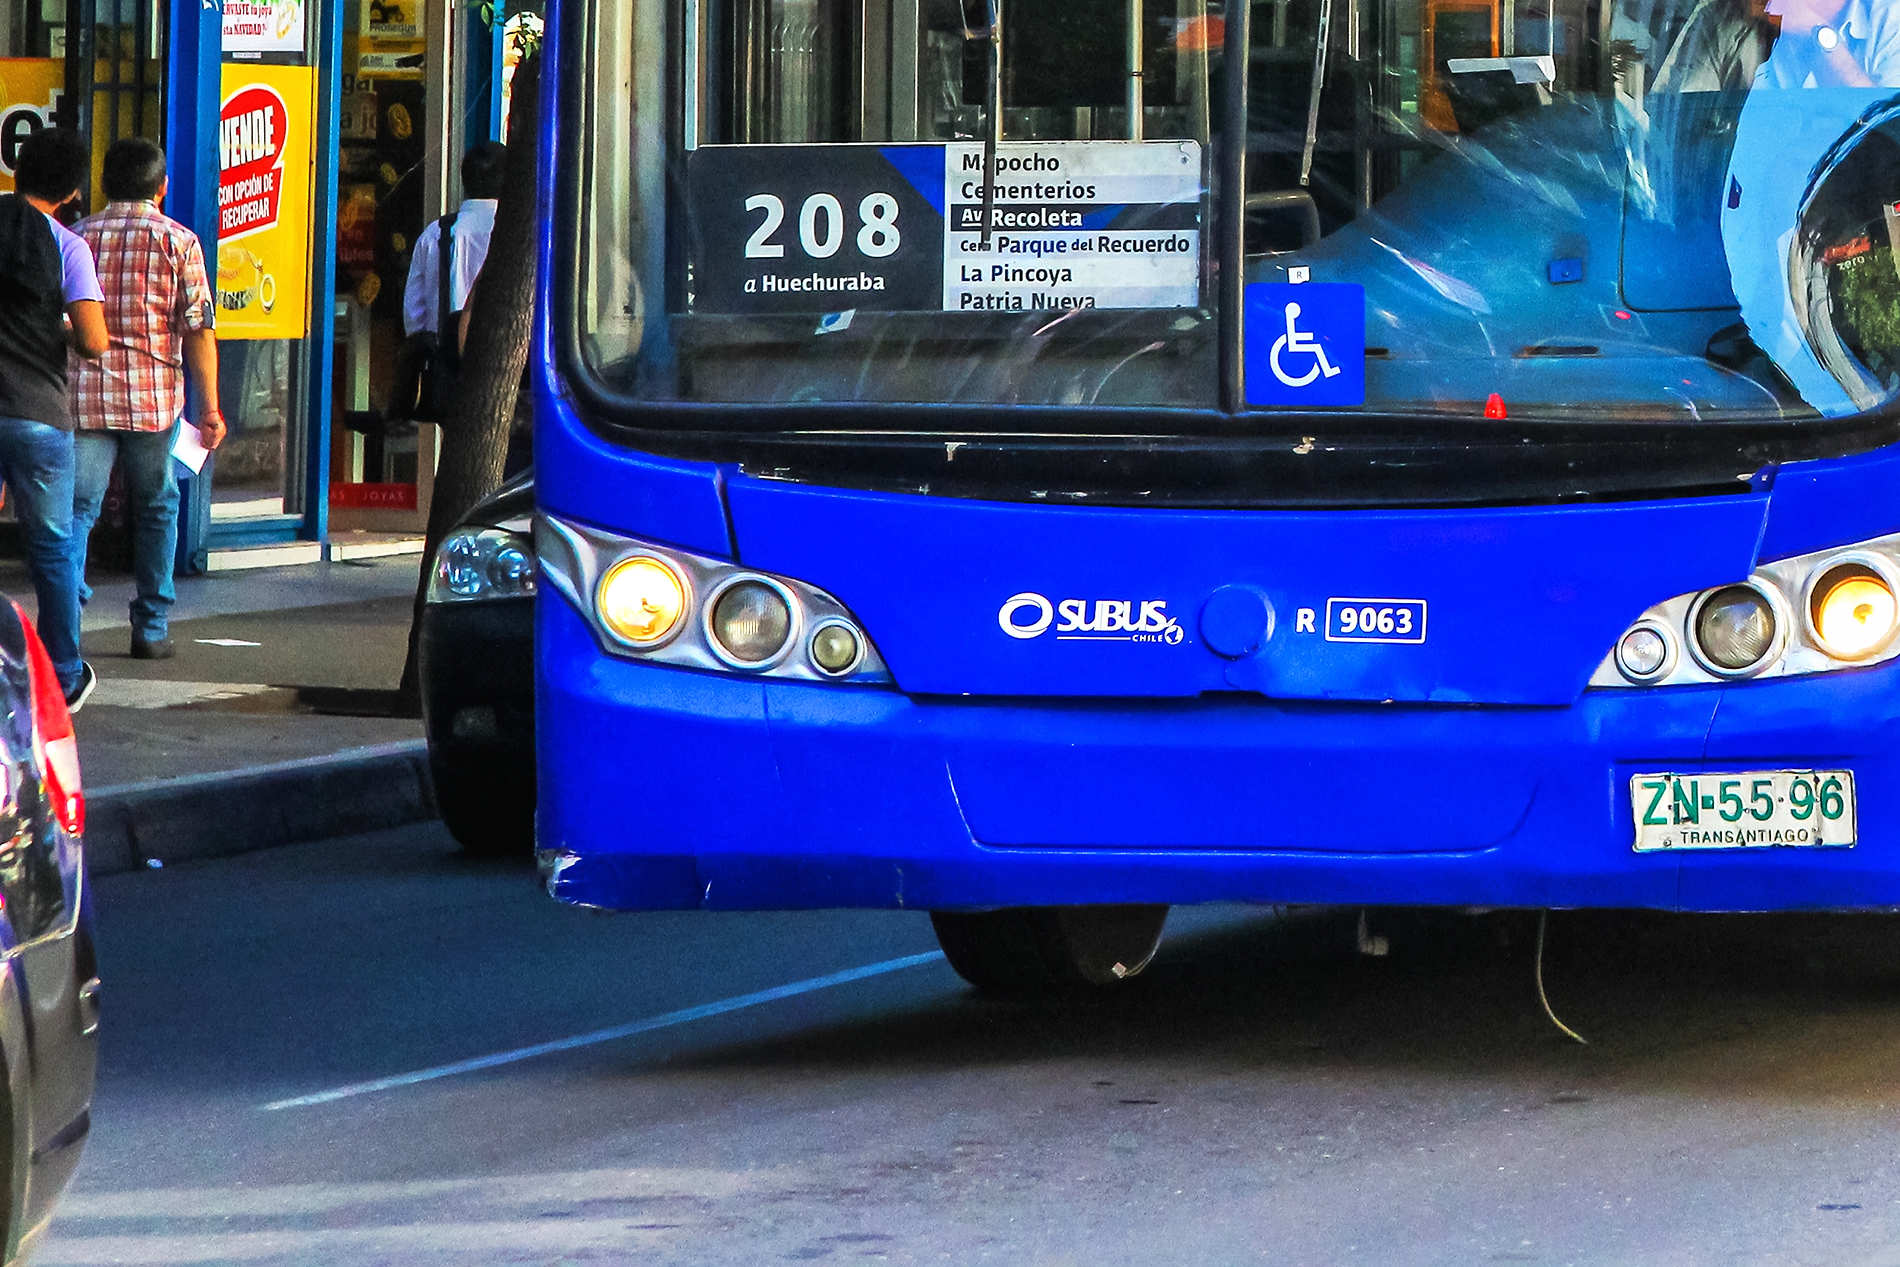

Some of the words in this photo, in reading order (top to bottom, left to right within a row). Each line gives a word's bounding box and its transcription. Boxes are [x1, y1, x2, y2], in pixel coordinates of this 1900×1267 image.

[220, 105, 275, 171] VENDE
[963, 153, 1060, 176] Mpocho
[218, 184, 234, 207] CON
[234, 172, 262, 201] OPCIÓN
[263, 172, 274, 193] DE
[961, 181, 1096, 199] Cementerios
[222, 197, 270, 231] RECUPERAR
[991, 208, 1083, 227] Recoleta
[744, 193, 901, 259] 208
[998, 236, 1067, 258] Parque
[1071, 238, 1094, 251] del
[1098, 234, 1190, 253] Recuerdo
[744, 279, 757, 293] a
[762, 272, 886, 293] Huechuraba
[961, 264, 983, 282] La
[991, 264, 1073, 287] Pincoya
[960, 292, 1023, 310] Patria
[1031, 292, 1095, 310] Nueva
[1056, 598, 1168, 633] SUBUS
[1296, 608, 1317, 634] R
[1340, 606, 1415, 634] 9063
[1132, 633, 1164, 643] CHILE
[1680, 829, 1810, 845] TRANSANTIAGO
